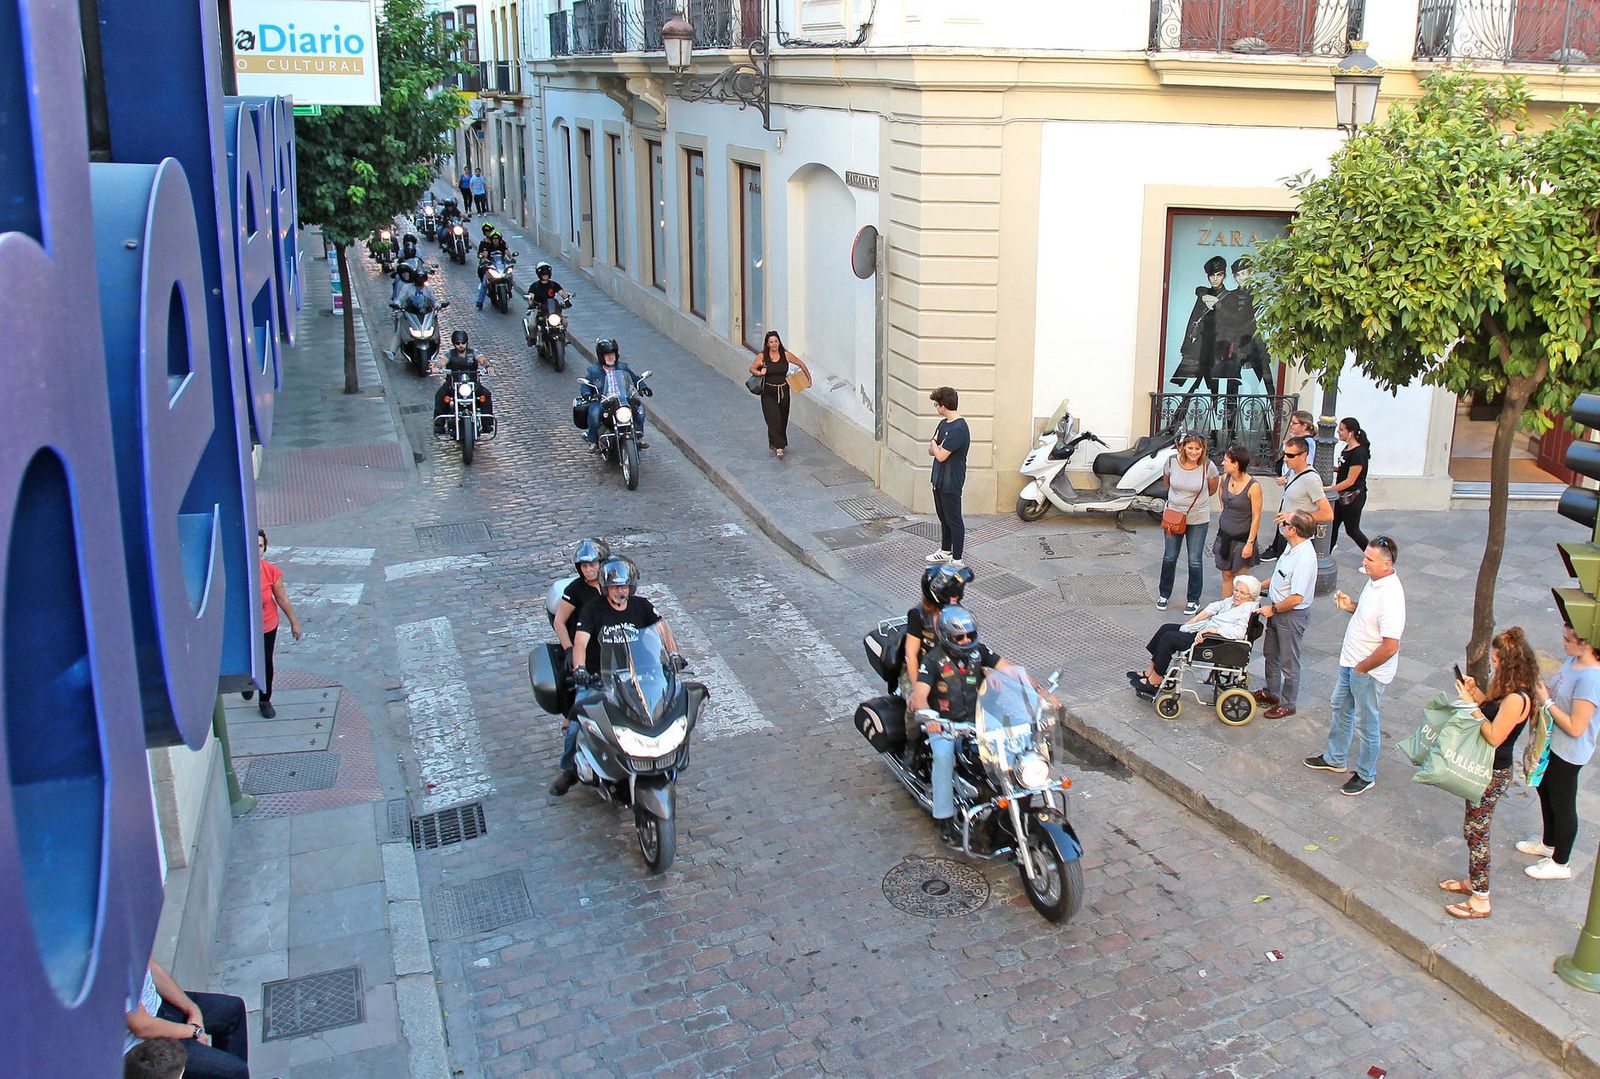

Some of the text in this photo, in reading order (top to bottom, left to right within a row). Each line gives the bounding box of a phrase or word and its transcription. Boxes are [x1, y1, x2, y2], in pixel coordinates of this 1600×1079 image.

[266, 59, 361, 72] CULTURAL
[1197, 229, 1260, 247] ZARA
[1444, 748, 1492, 779] PULL&BEA
